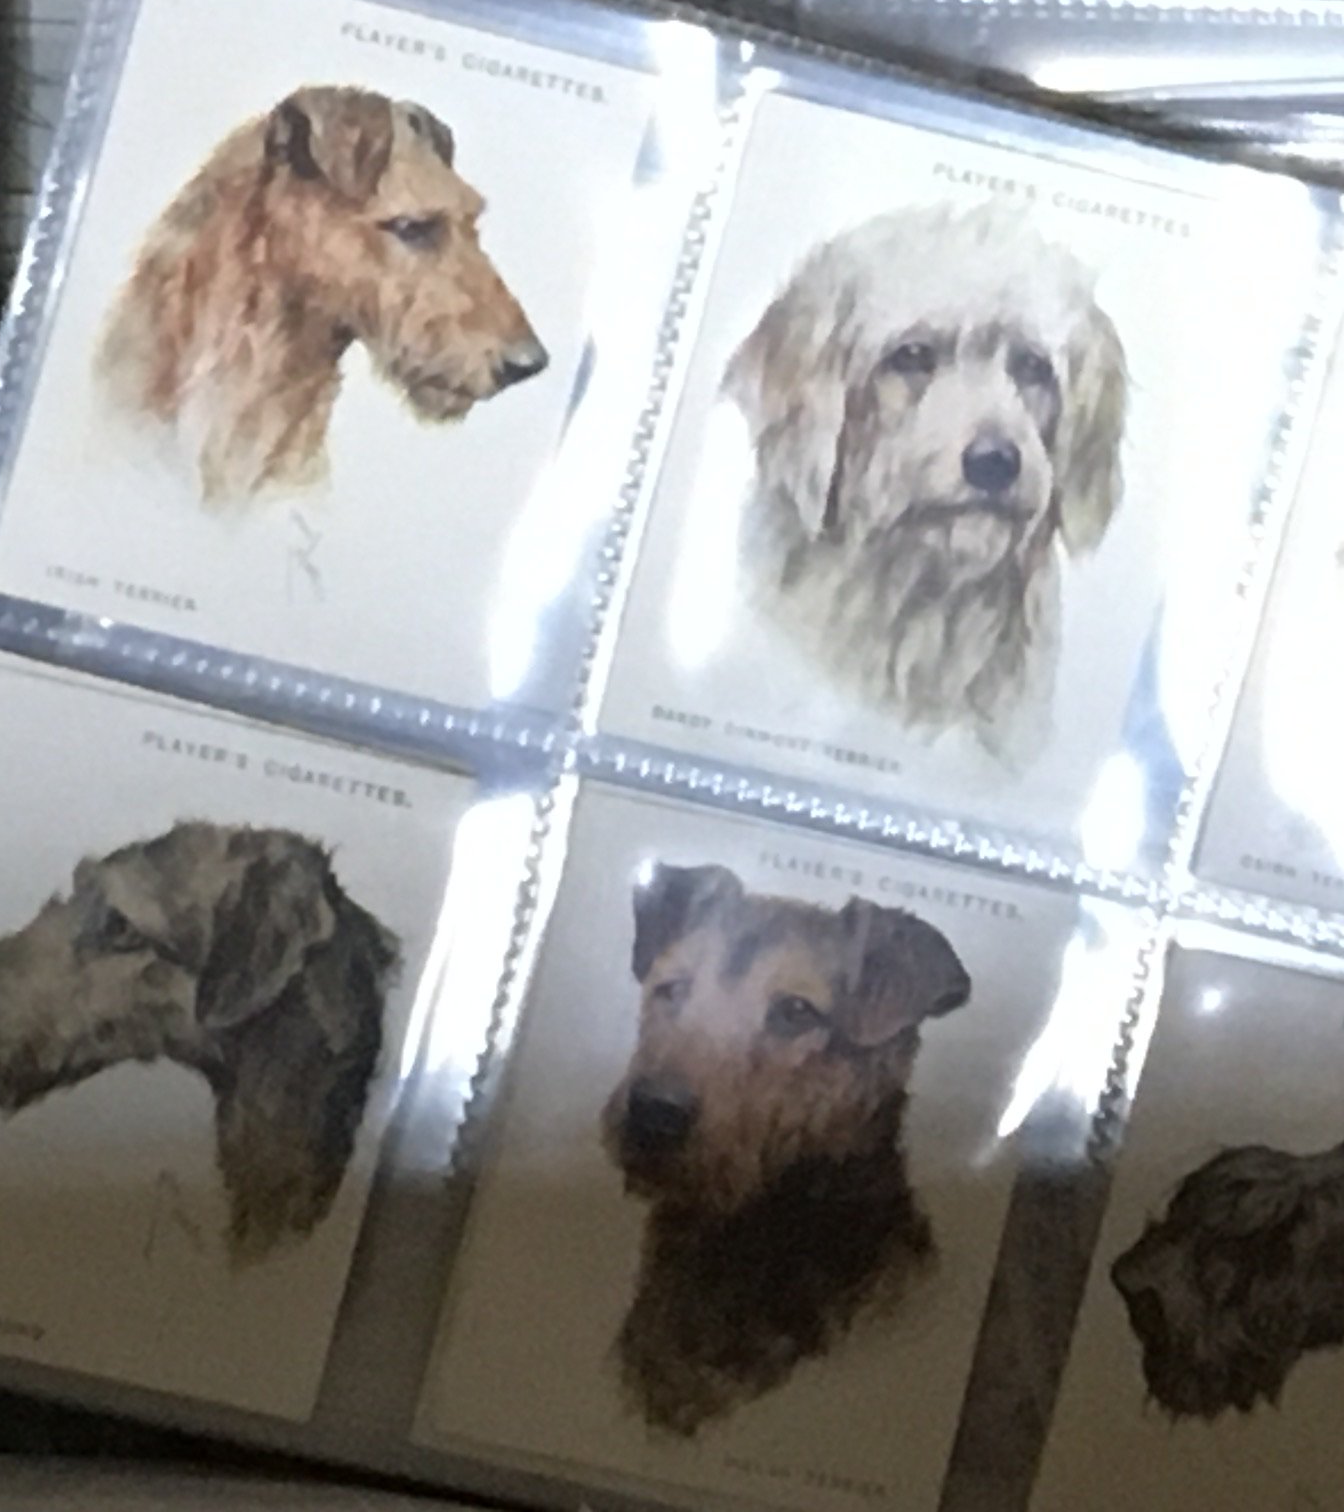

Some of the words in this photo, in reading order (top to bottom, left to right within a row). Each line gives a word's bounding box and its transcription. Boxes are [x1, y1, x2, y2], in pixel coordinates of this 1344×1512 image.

[340, 20, 447, 62] PLAYER'S
[933, 161, 1037, 200] PLAYER'S
[113, 579, 198, 612] TERRIER
[142, 730, 249, 770] PLAYER'S
[759, 851, 863, 886] PLAYER'S
